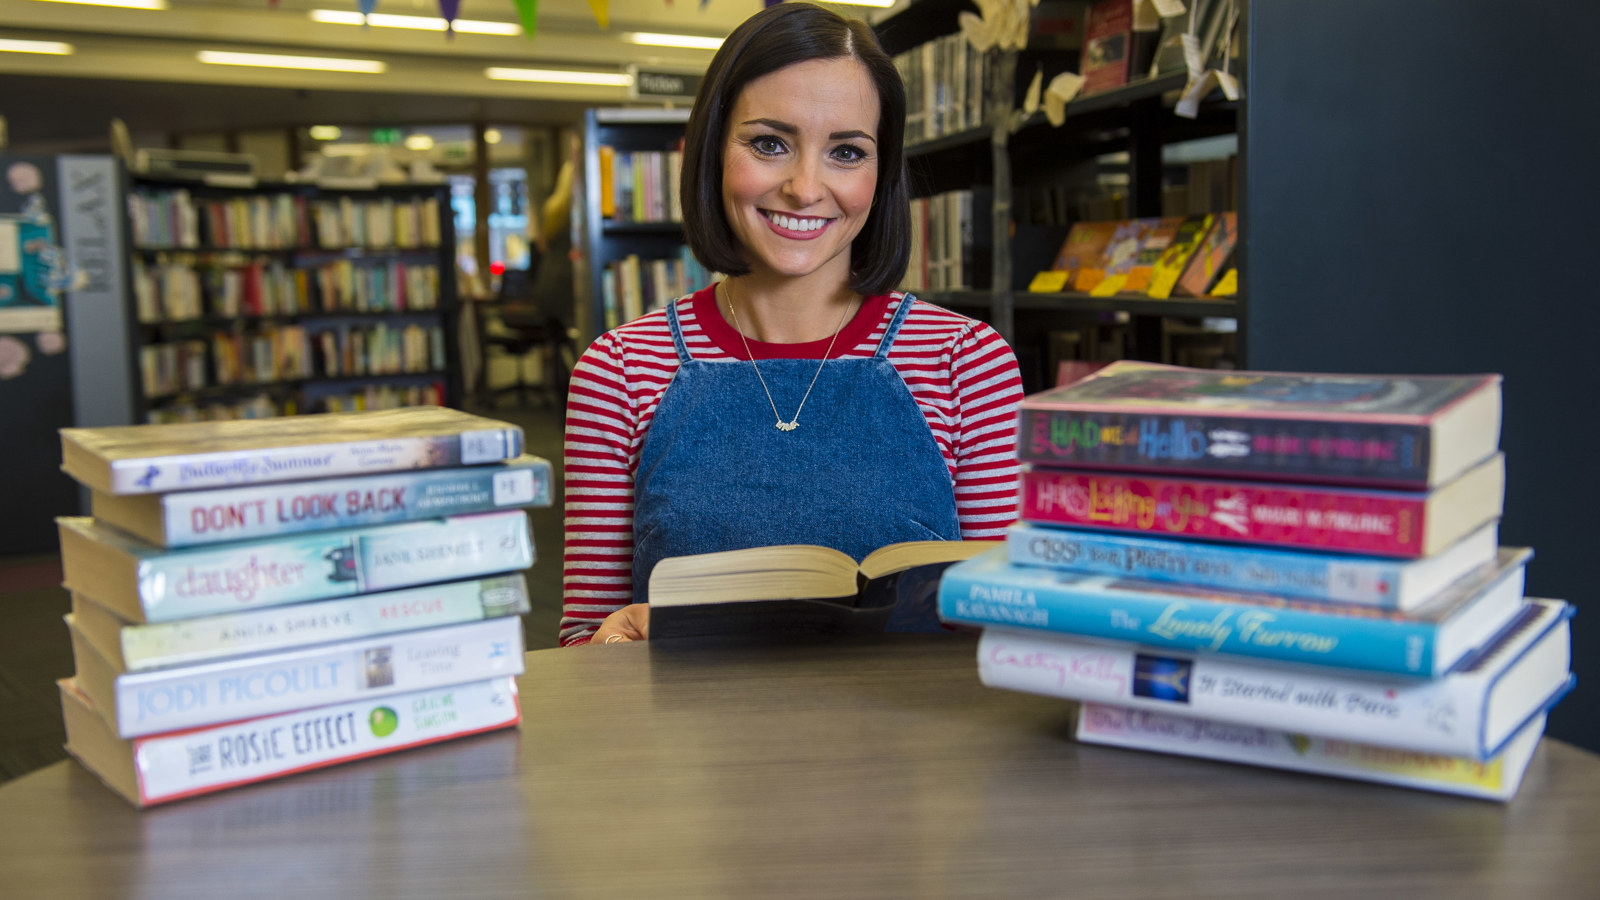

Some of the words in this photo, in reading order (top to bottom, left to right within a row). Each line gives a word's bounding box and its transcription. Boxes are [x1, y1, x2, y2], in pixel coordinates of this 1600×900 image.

[1050, 418, 1100, 448] HAD
[1138, 419, 1208, 460] Hello
[190, 499, 266, 534] DON'T
[277, 493, 339, 523] LOOK
[346, 486, 407, 516] BACK
[1088, 479, 1156, 530] Looking
[175, 555, 306, 602] daughter
[969, 584, 1038, 606] PAMELA
[219, 625, 278, 642] ANITA
[285, 610, 353, 633] SHREVE
[380, 599, 443, 619] RESCUE
[1148, 600, 1235, 652] Lonely
[1236, 608, 1340, 653] Furrow
[135, 681, 208, 724] JODI
[218, 660, 342, 705] PICOULT
[291, 711, 357, 754] EFFECT
